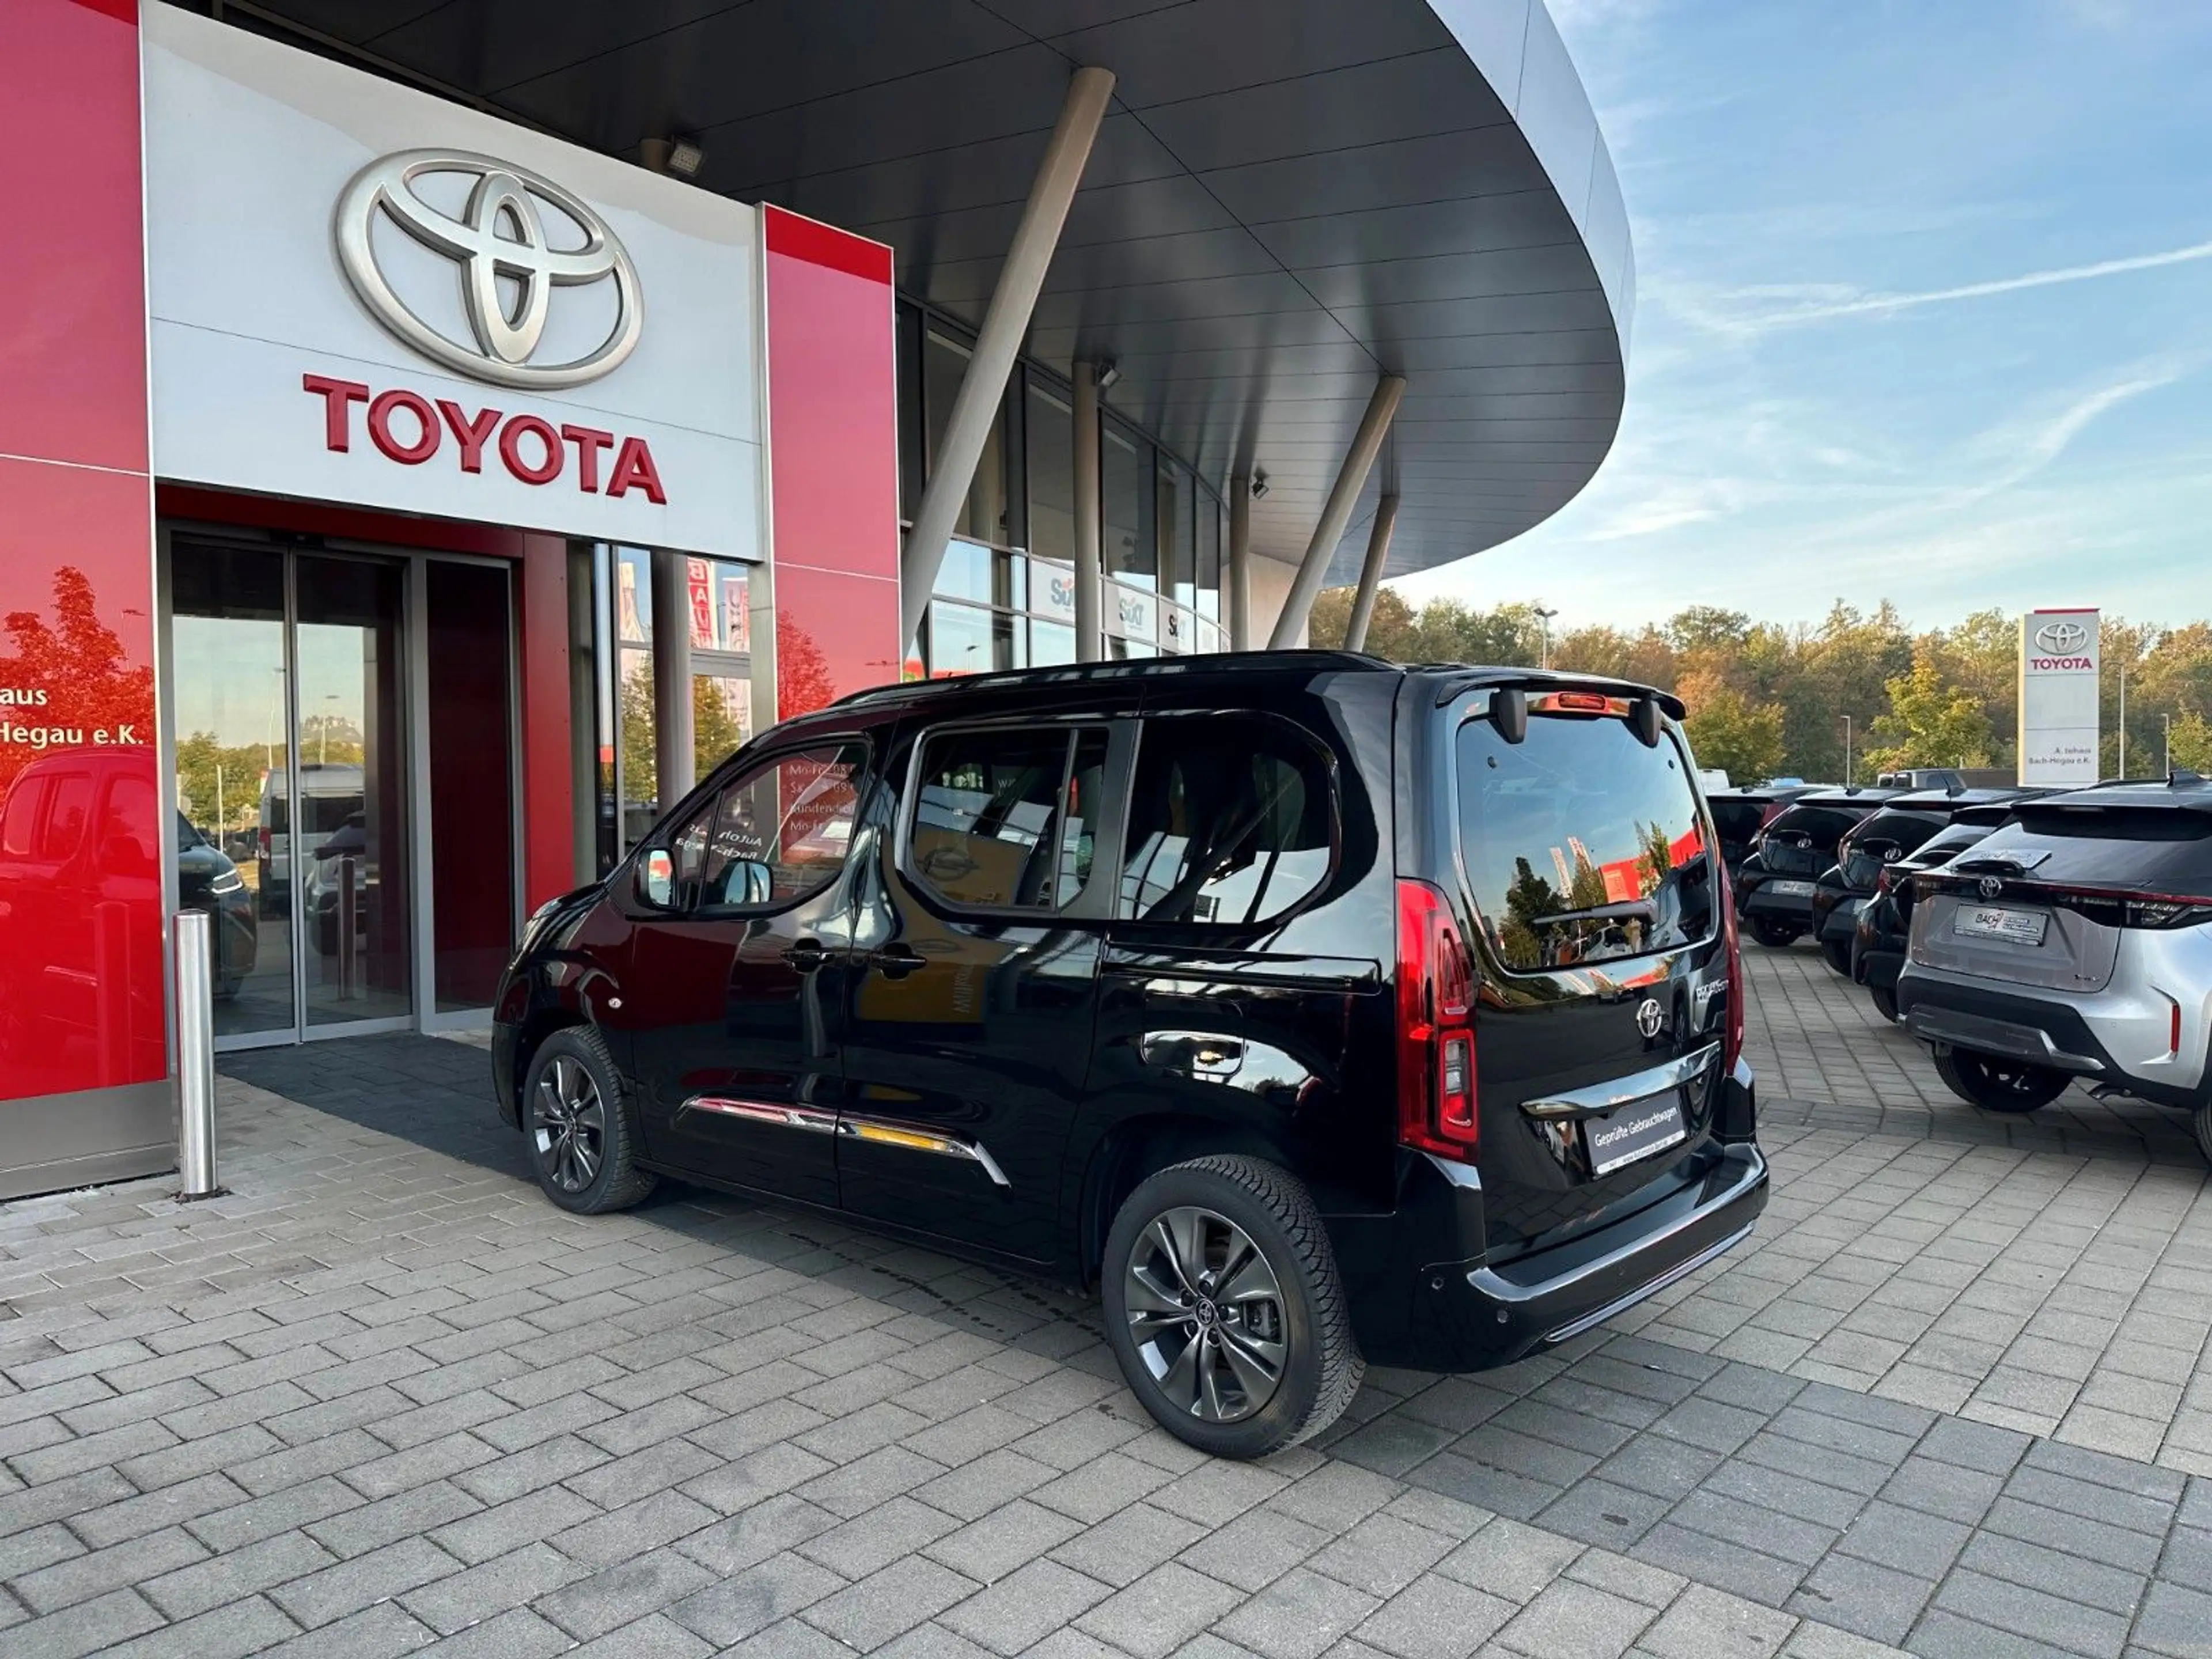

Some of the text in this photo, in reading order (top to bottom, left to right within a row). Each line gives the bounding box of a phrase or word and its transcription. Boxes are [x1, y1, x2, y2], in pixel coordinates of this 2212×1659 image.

[303, 373, 667, 505] TOYOTA
[2031, 658, 2092, 669] TOYOTA
[93, 724, 143, 744] e.K.
[1628, 1107, 1677, 1134] Gebrauchtwagen
